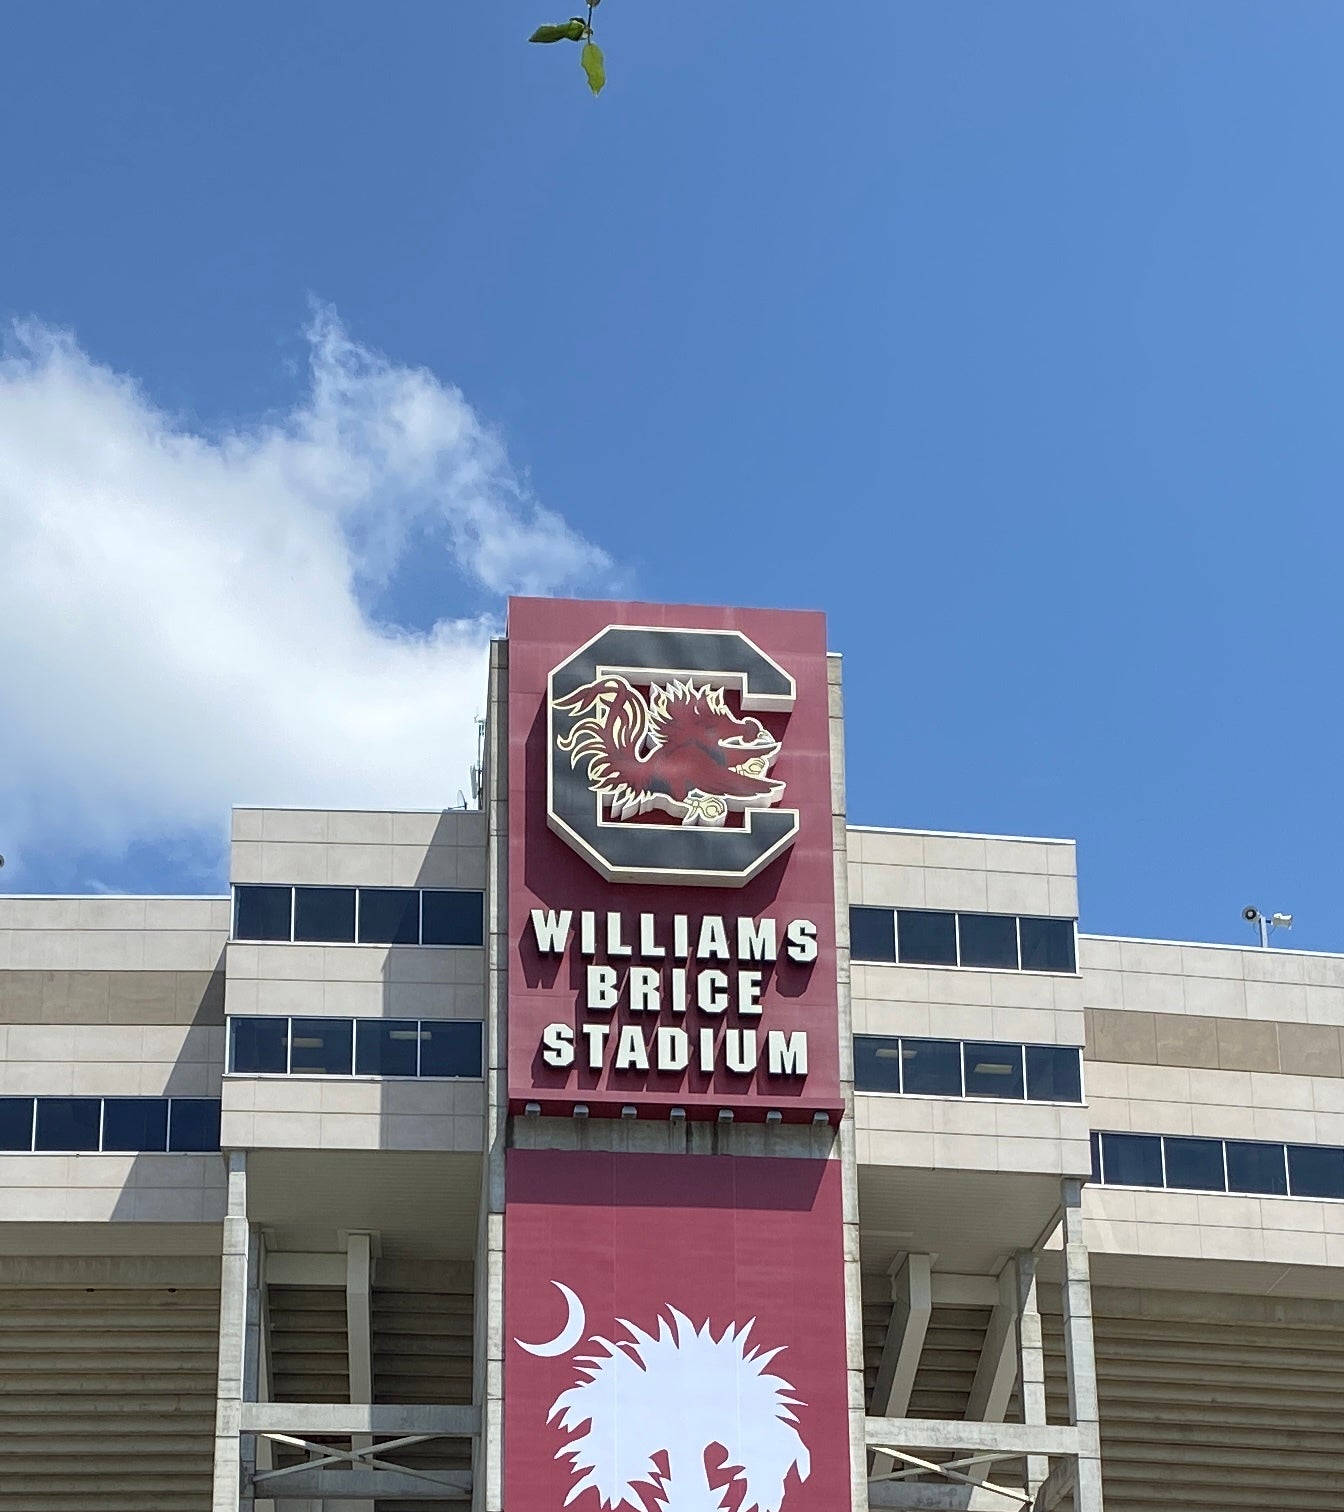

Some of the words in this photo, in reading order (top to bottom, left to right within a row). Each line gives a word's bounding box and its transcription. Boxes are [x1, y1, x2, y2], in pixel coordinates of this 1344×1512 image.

[530, 909, 818, 963] WILLIAMS
[586, 965, 764, 1015] BRICE
[542, 1022, 809, 1076] STADIUM
